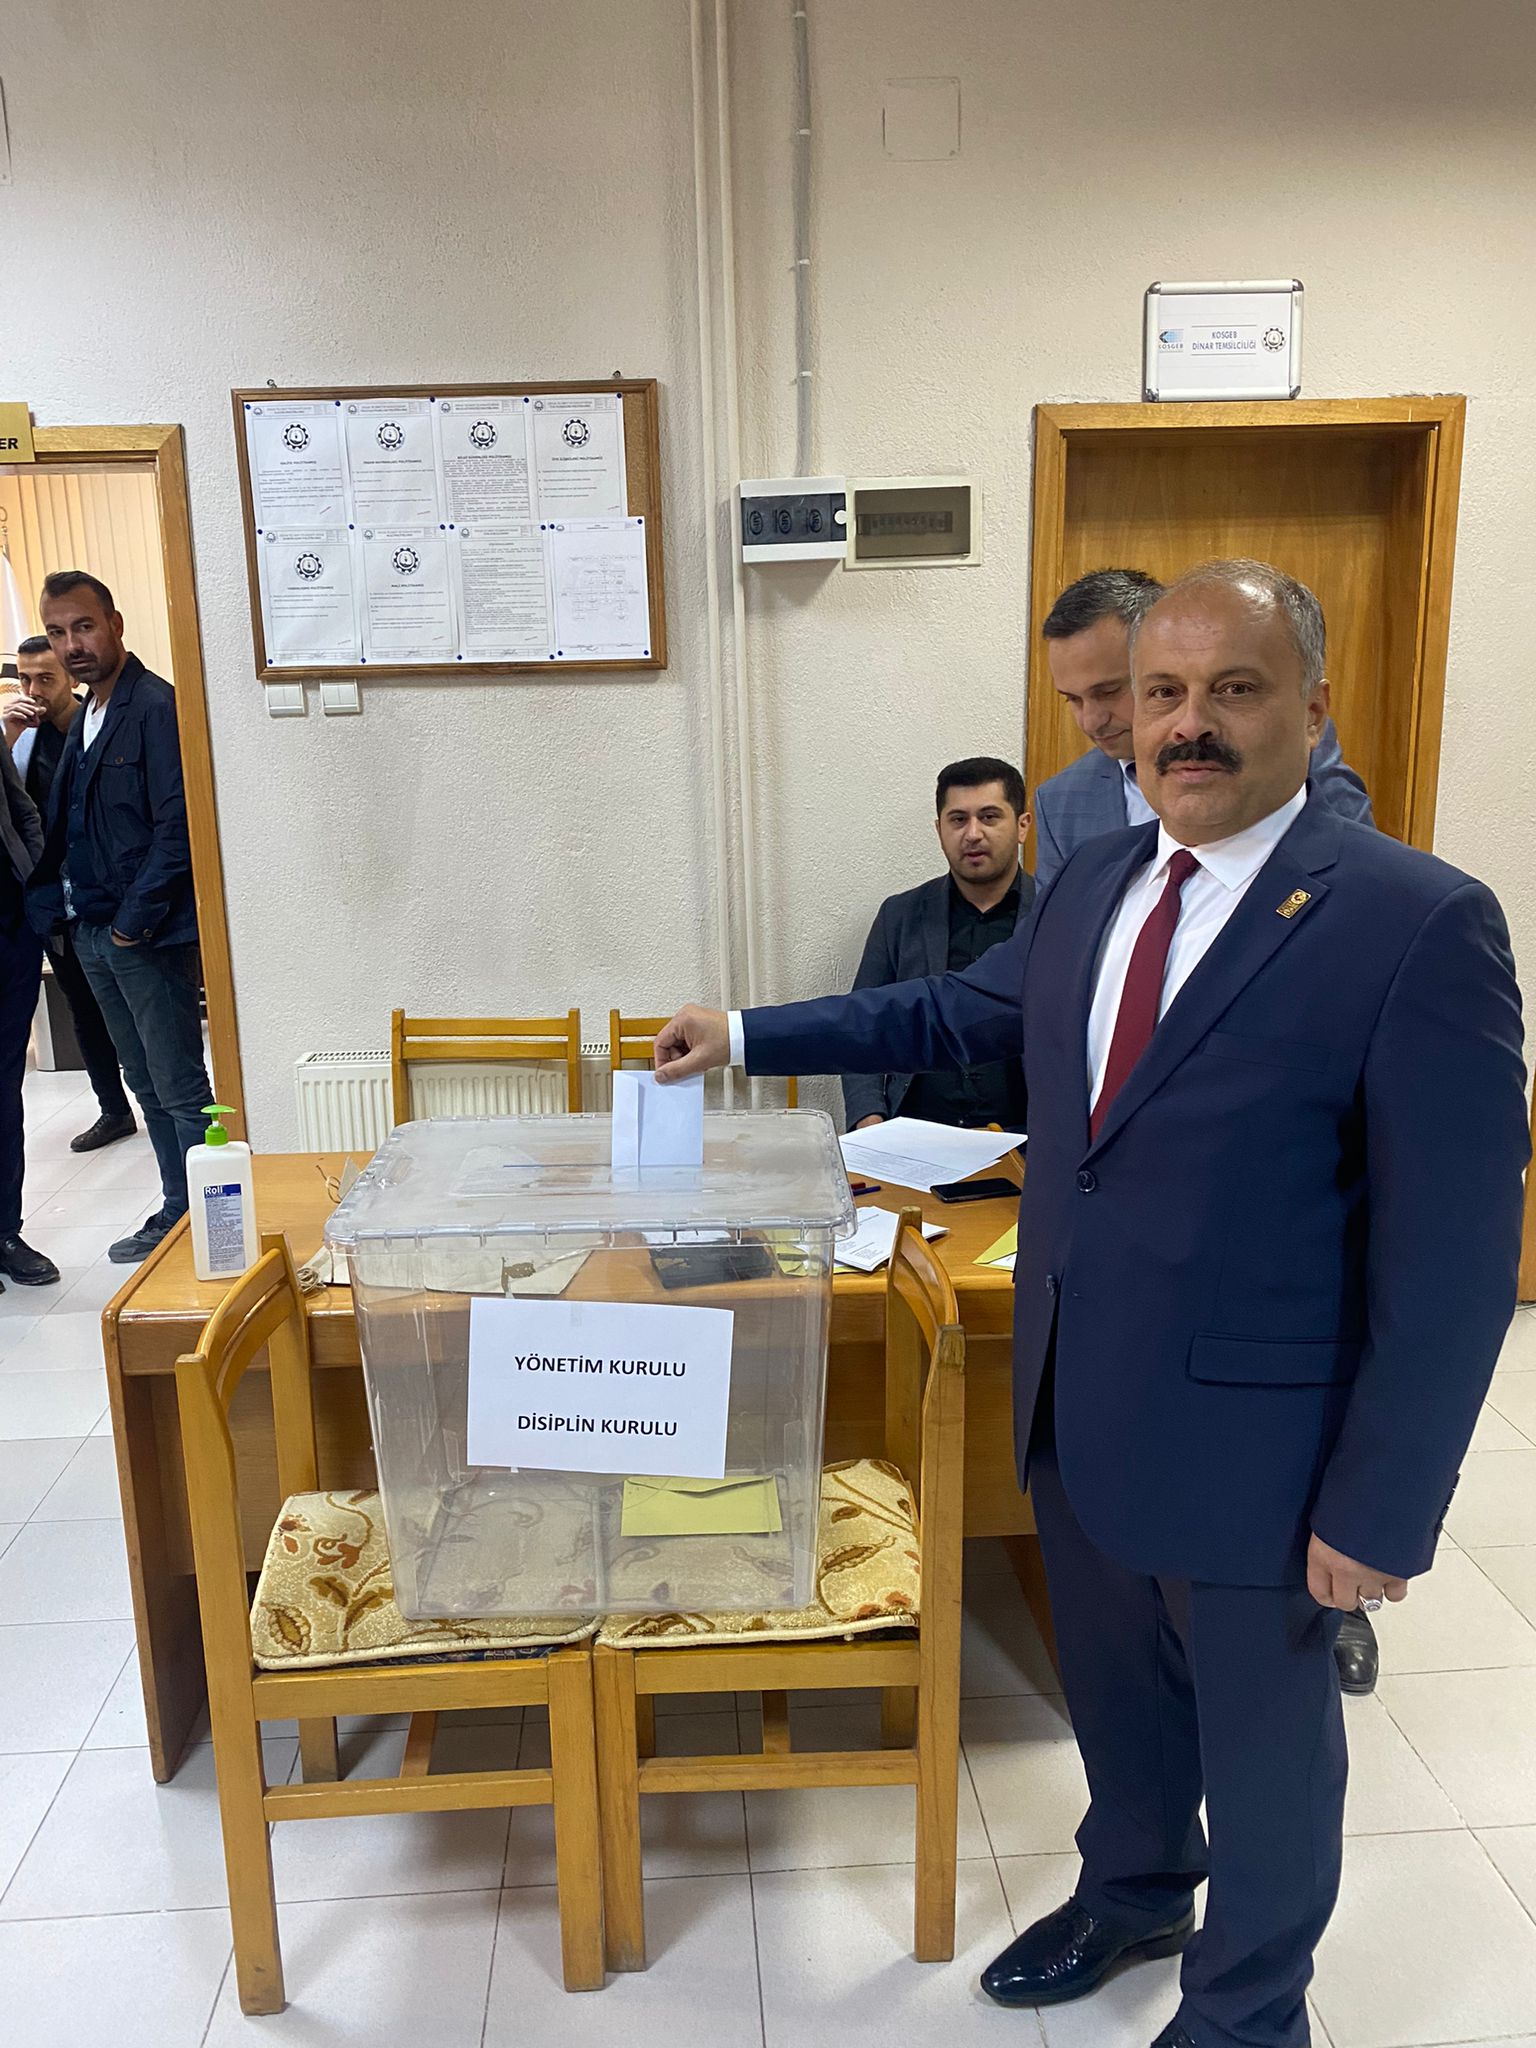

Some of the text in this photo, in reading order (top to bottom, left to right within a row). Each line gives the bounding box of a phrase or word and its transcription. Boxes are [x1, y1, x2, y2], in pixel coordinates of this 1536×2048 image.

[1211, 330, 1238, 339] KOSGEB
[1192, 341, 1214, 350] DİNAR
[205, 1186, 223, 1195] Roll
[514, 1353, 686, 1377] YÖNETİM KURULU
[517, 1412, 678, 1436] DİSİPLİN KURULU
